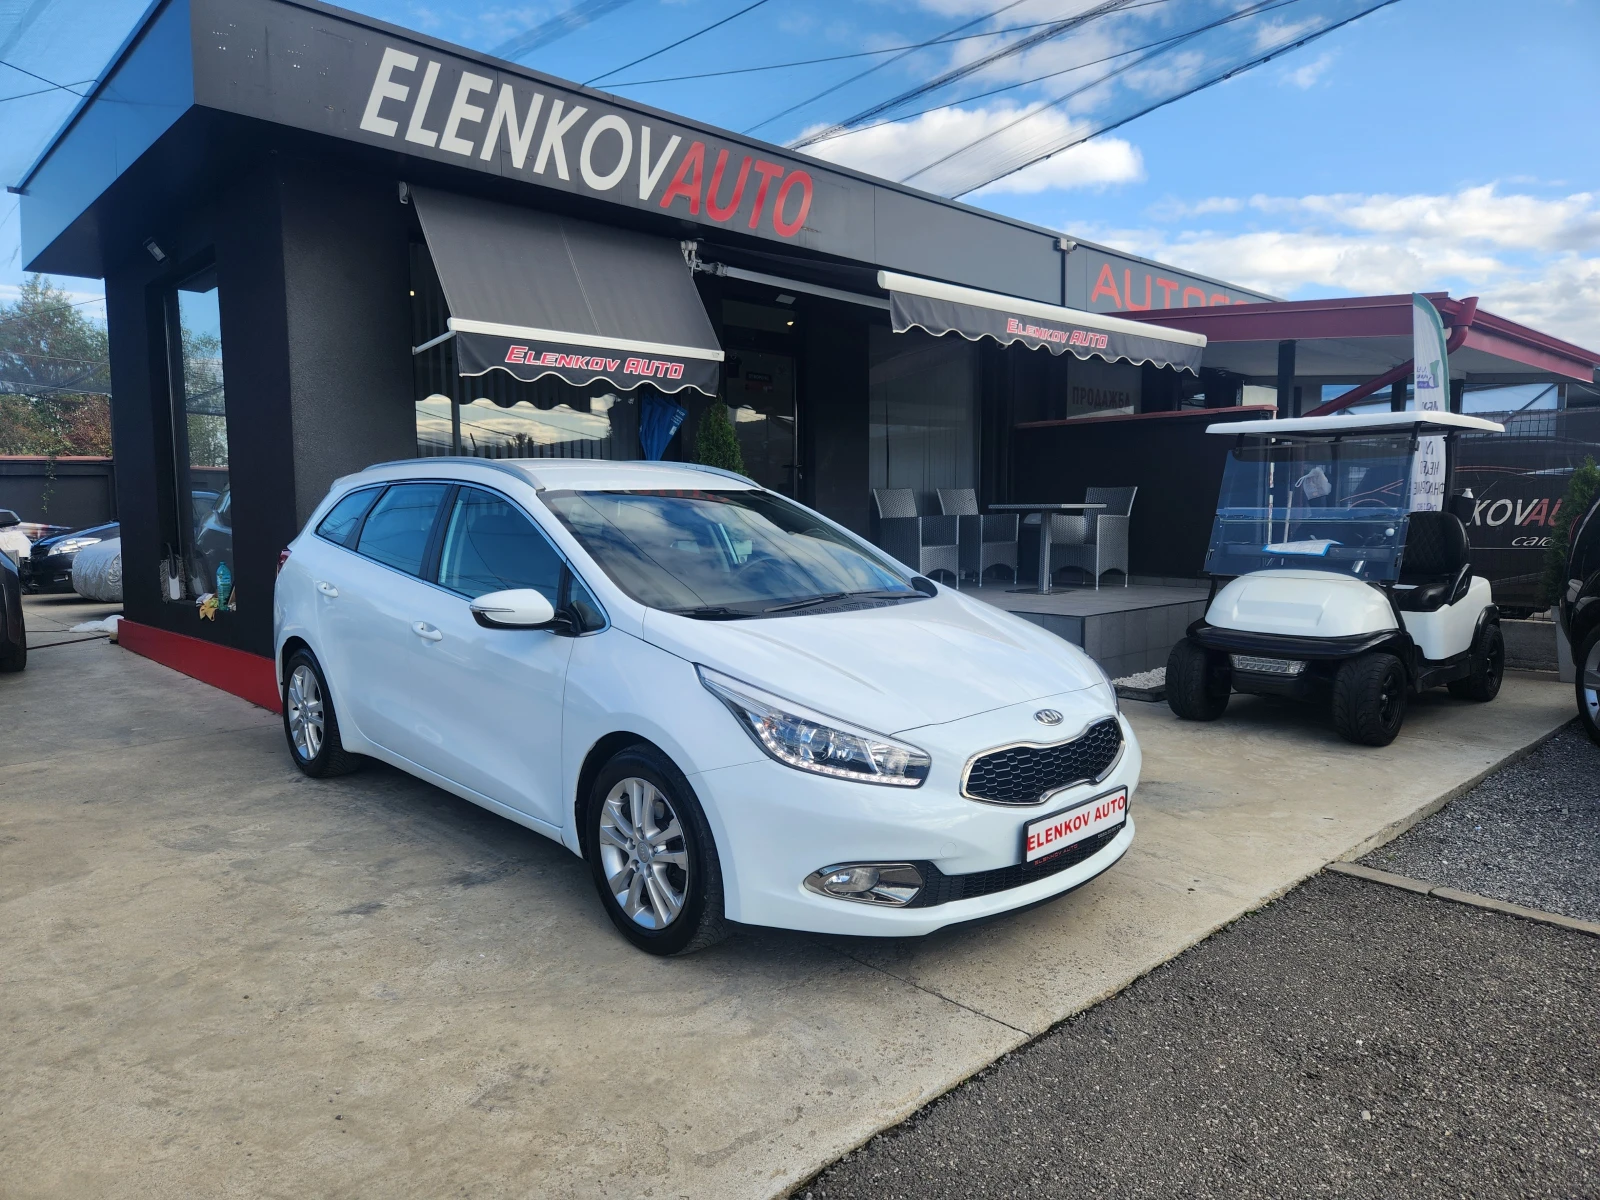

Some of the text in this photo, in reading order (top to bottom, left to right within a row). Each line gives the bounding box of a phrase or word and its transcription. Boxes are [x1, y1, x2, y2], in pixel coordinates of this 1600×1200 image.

[1006, 318, 1109, 349] ELENKOV AUTO
[505, 345, 685, 379] ELENKOV AUTO
[1072, 386, 1131, 408] ПРОДАЖБА
[1038, 711, 1062, 724] KIA
[1027, 811, 1091, 852] ELENKOV
[1093, 795, 1126, 822] AUTO
